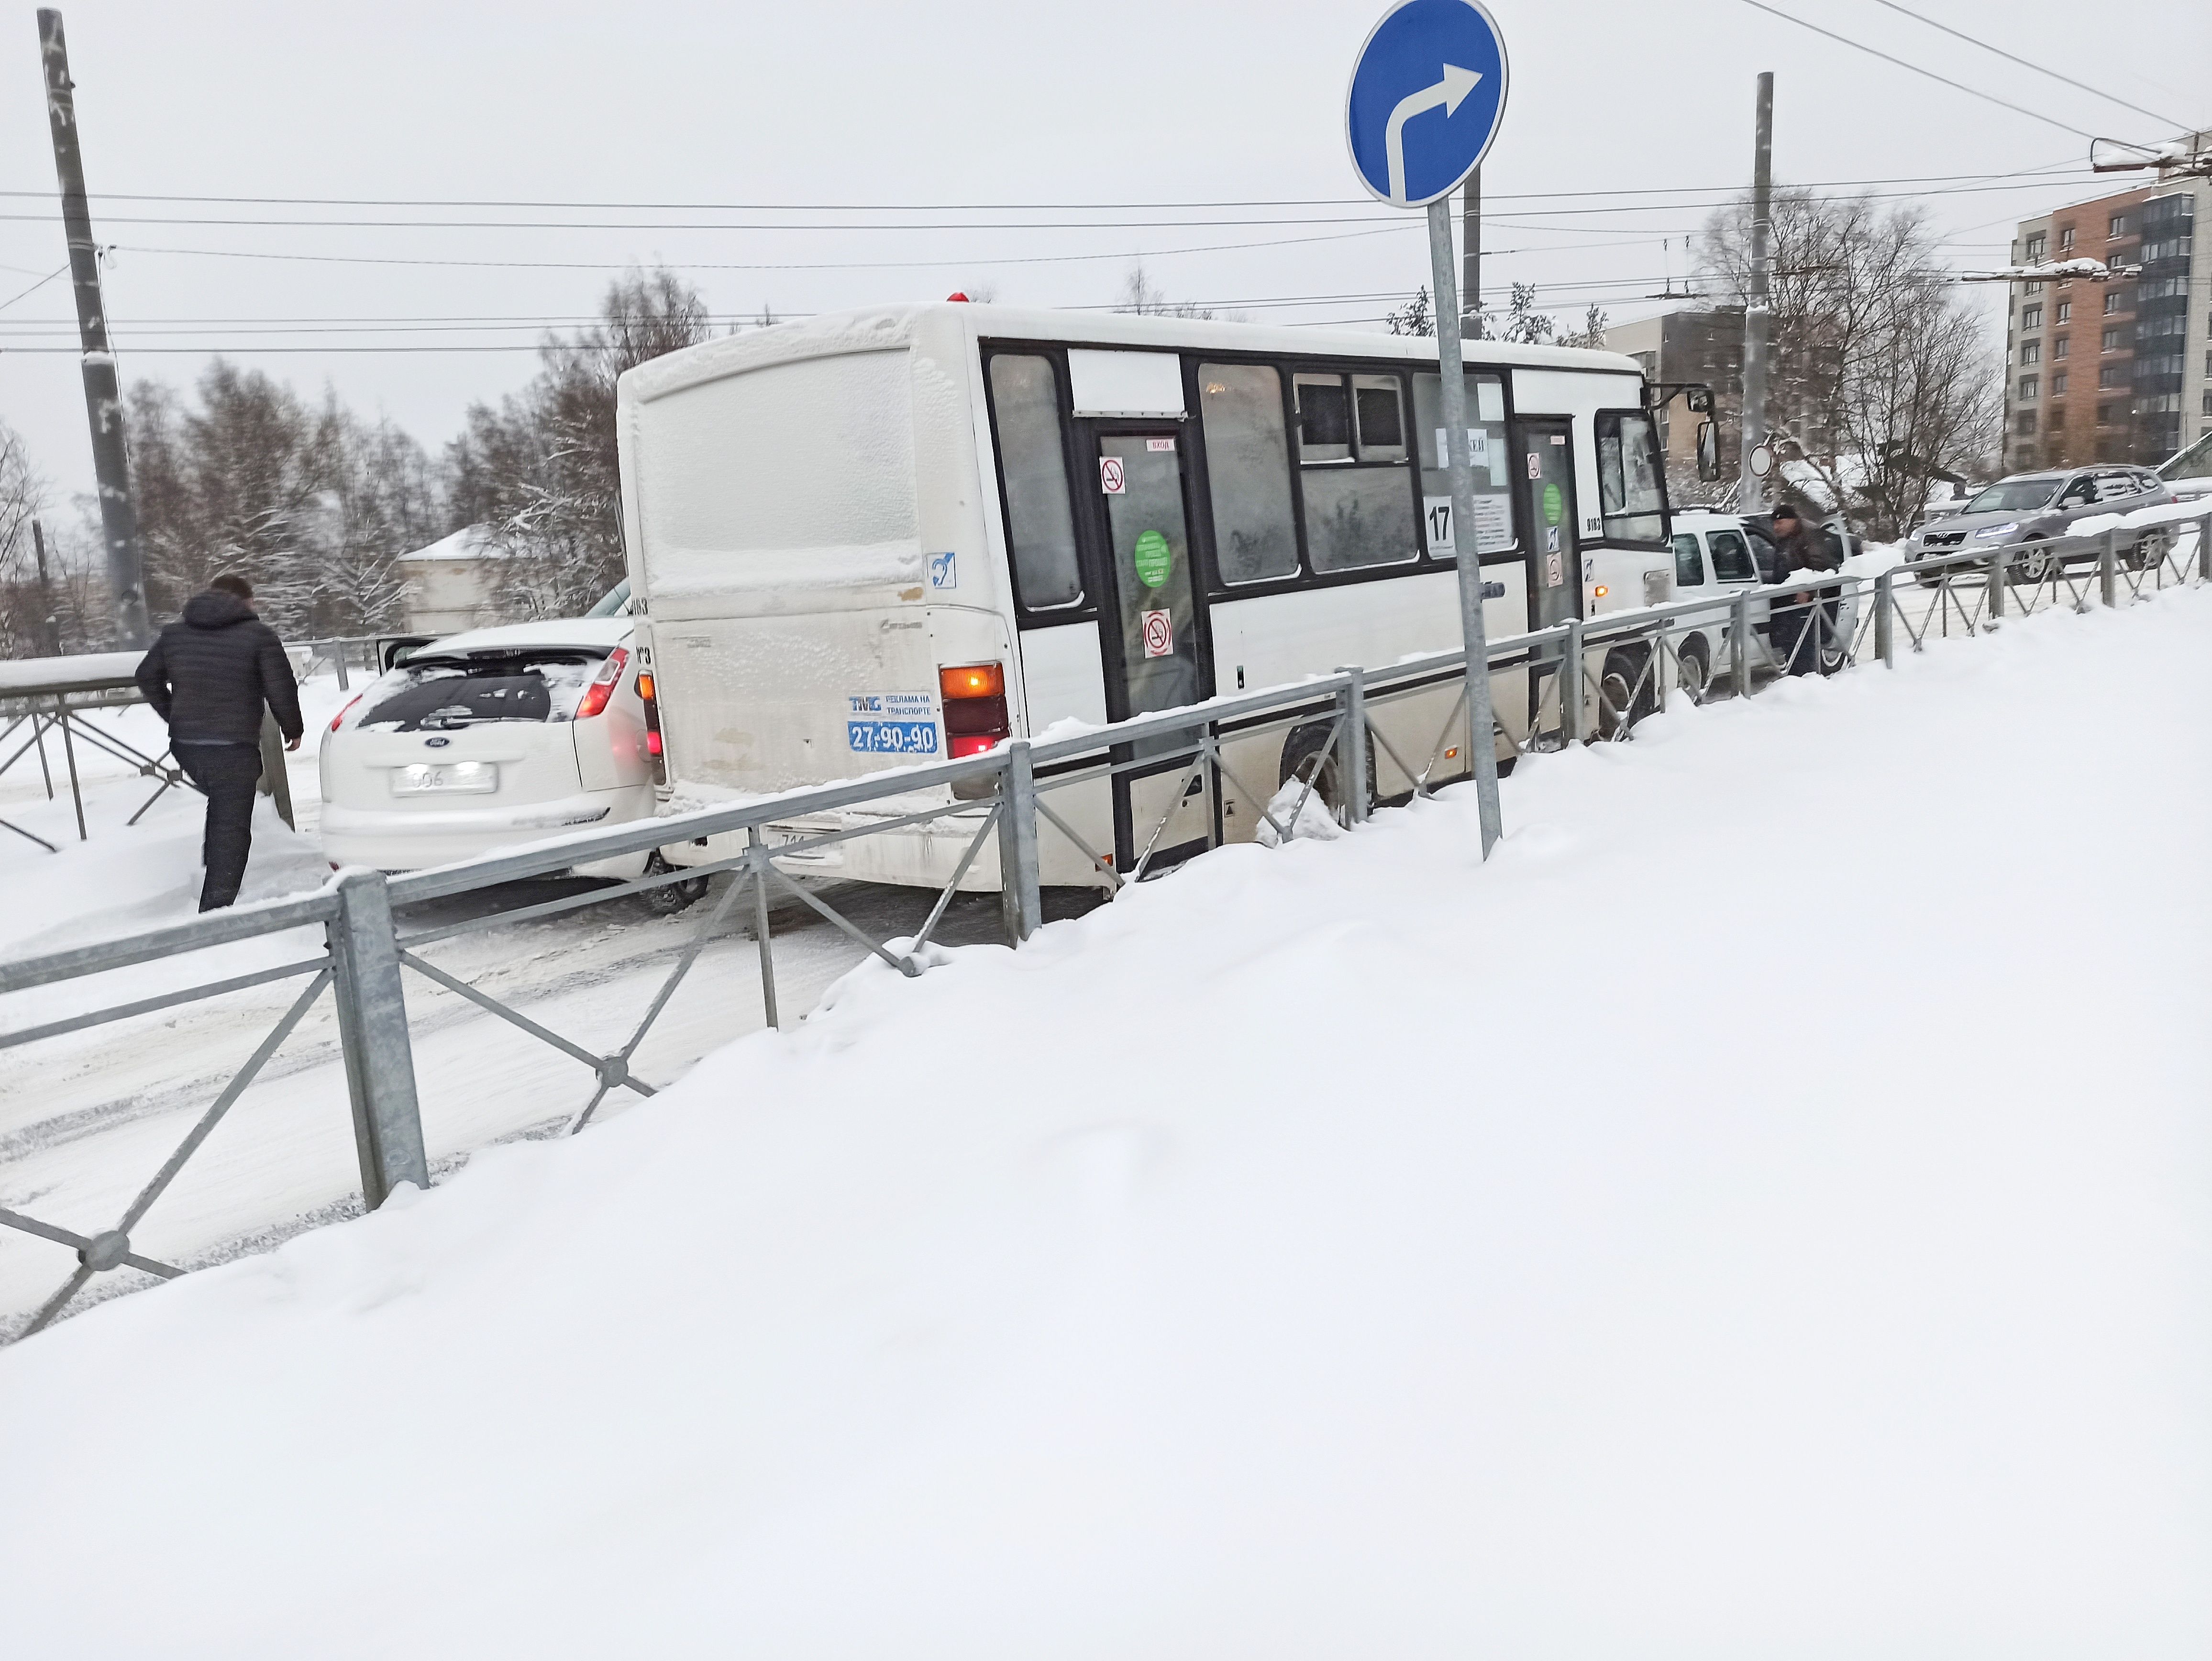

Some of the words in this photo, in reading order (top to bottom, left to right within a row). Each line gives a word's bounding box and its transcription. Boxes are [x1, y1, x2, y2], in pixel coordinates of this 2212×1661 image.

[1429, 505, 1450, 542] 17
[886, 707, 931, 716] ТРАНСПОРТЕ
[852, 726, 933, 750] 27-90-90
